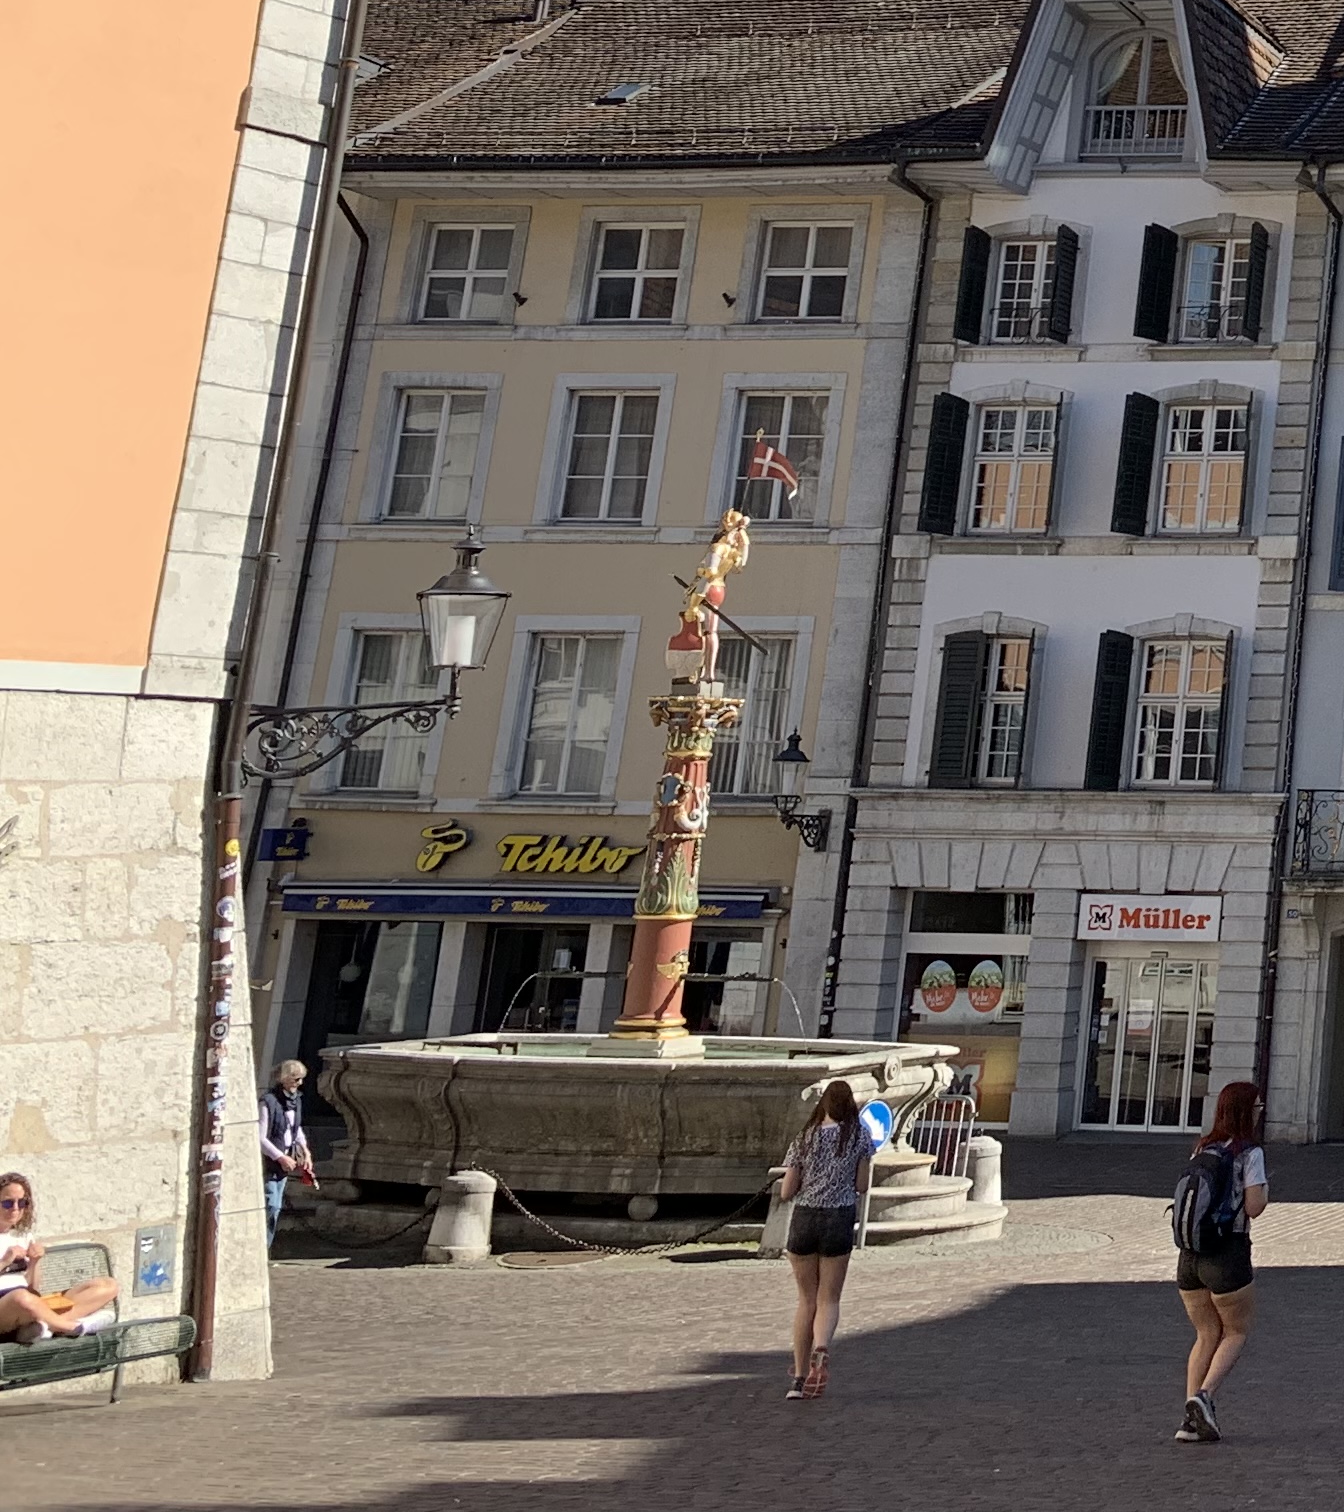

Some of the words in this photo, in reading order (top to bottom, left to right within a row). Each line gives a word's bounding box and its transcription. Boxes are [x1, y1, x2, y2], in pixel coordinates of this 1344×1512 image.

[496, 834, 647, 873] Tchibo
[335, 899, 375, 910] Tchibo
[511, 900, 550, 913] Tchibo
[1094, 912, 1107, 924] M
[1118, 907, 1212, 929] Müller
[1288, 910, 1298, 918] 50
